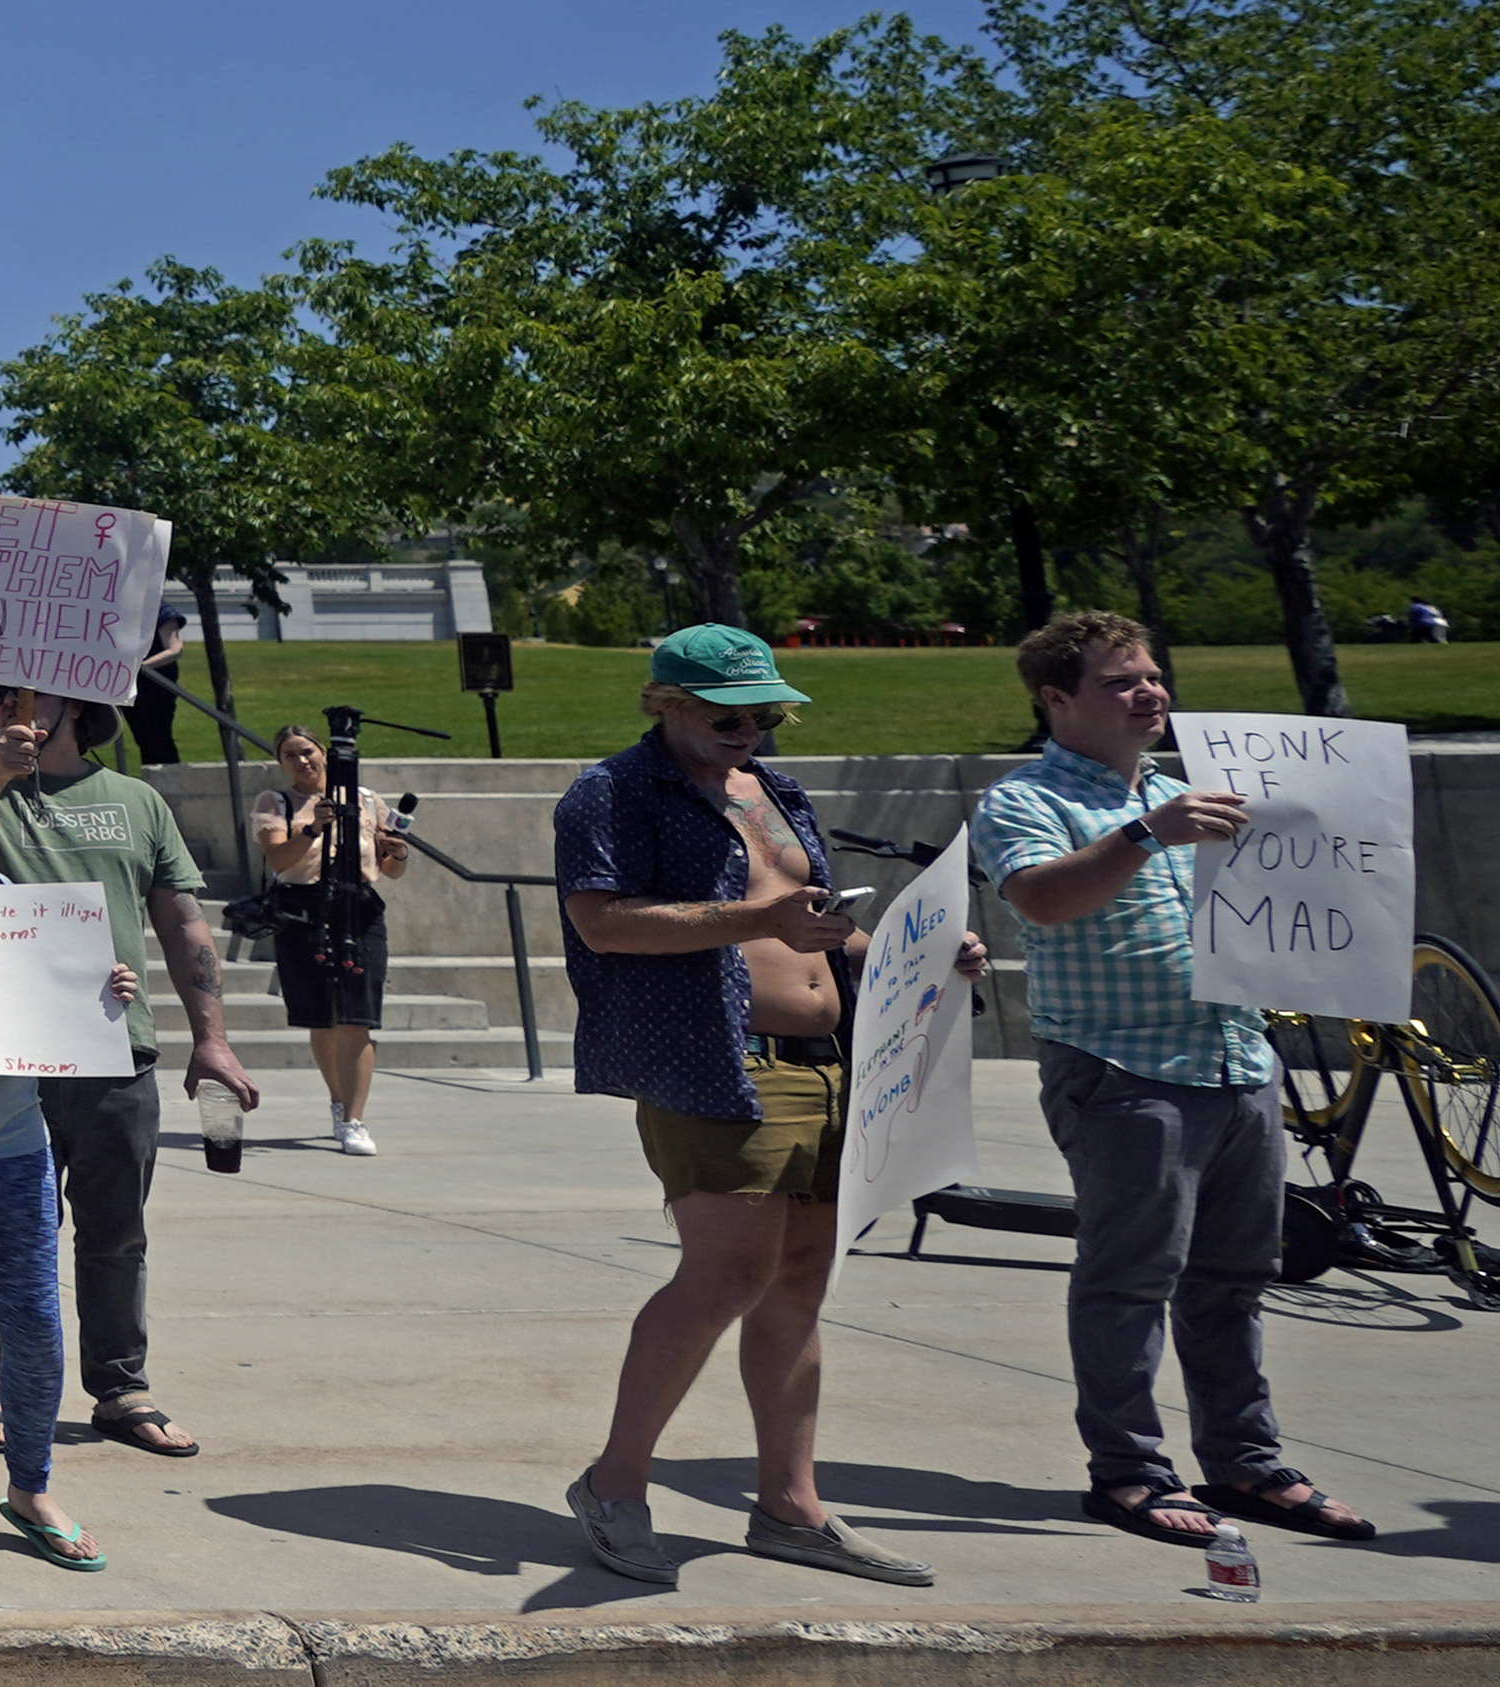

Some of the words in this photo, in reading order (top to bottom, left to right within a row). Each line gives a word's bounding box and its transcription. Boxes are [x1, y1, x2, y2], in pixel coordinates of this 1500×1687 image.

[16, 599, 120, 649] THEIR
[1203, 727, 1350, 765] HONK
[1220, 768, 1281, 800] IF
[1226, 828, 1380, 874] YOU'RE
[33, 901, 50, 918] it
[1210, 889, 1354, 954] MAD
[868, 931, 893, 993] WE
[902, 898, 947, 954] NEED
[5, 1057, 79, 1075] shroom
[855, 1019, 911, 1090] ELEPHANT
[862, 1074, 912, 1130] WOMB
